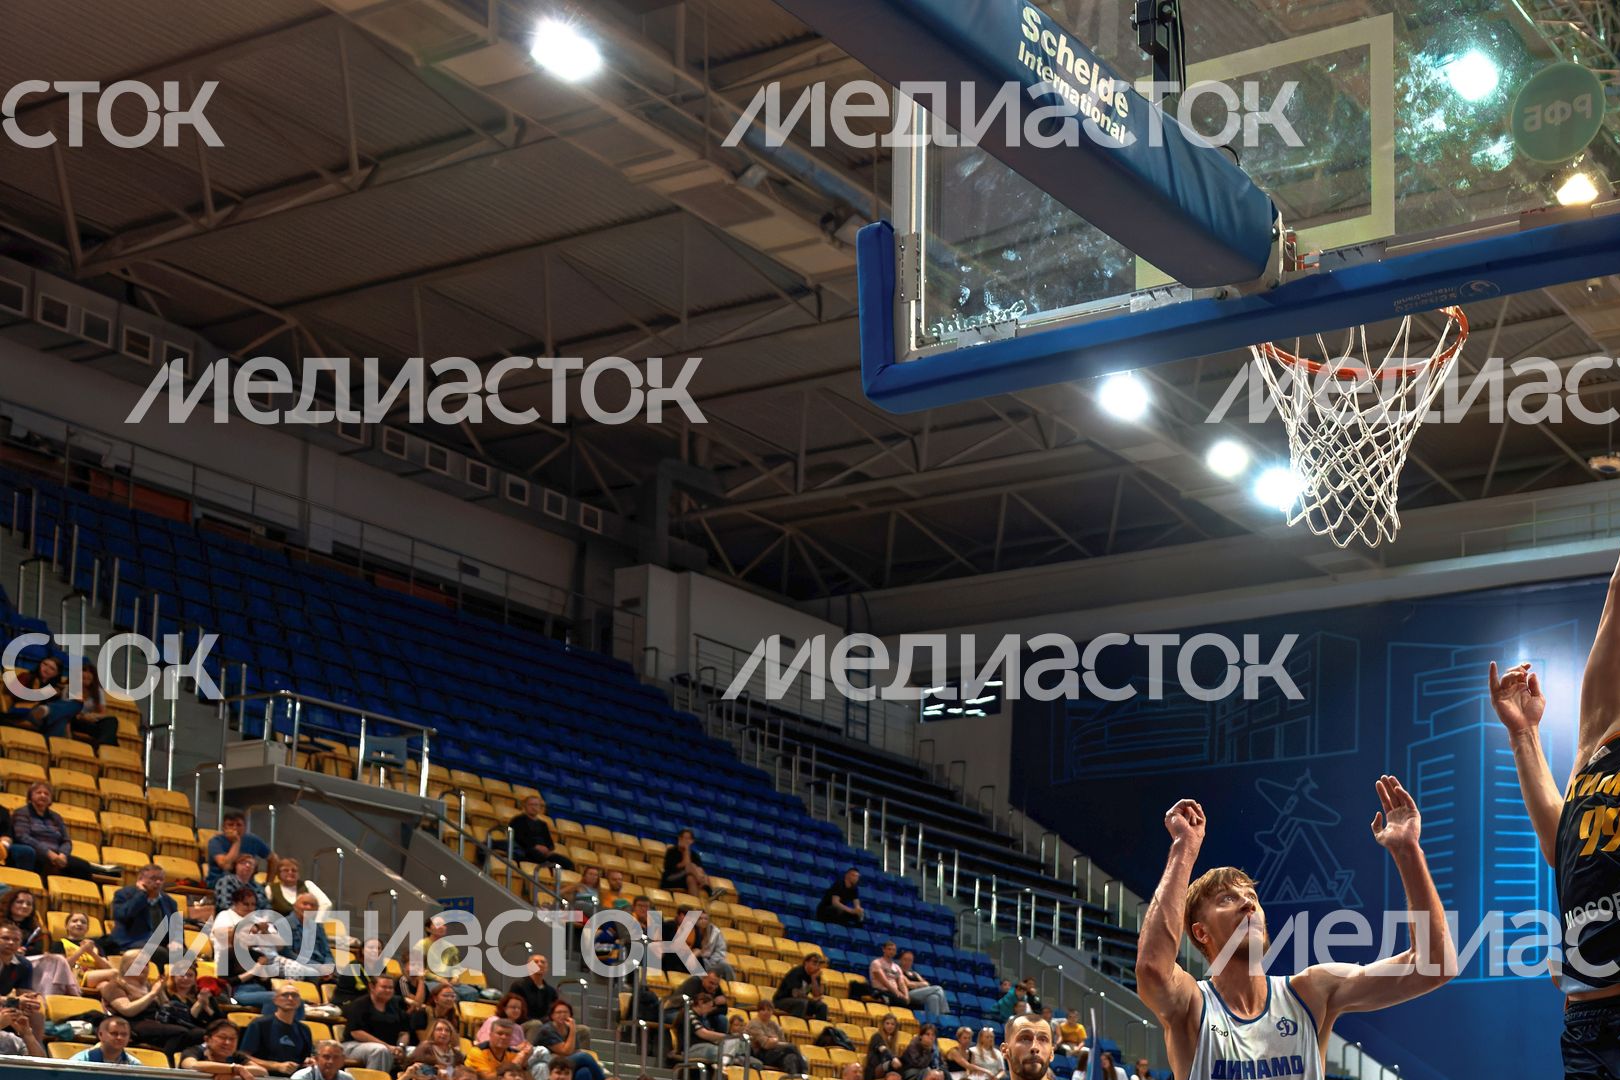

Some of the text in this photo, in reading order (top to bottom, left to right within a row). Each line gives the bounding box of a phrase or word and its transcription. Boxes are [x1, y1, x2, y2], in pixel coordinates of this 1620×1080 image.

[1017, 40, 1126, 145] International
[1021, 6, 1129, 118] Schelde
[1211, 1055, 1305, 1080] ДИНАМО
